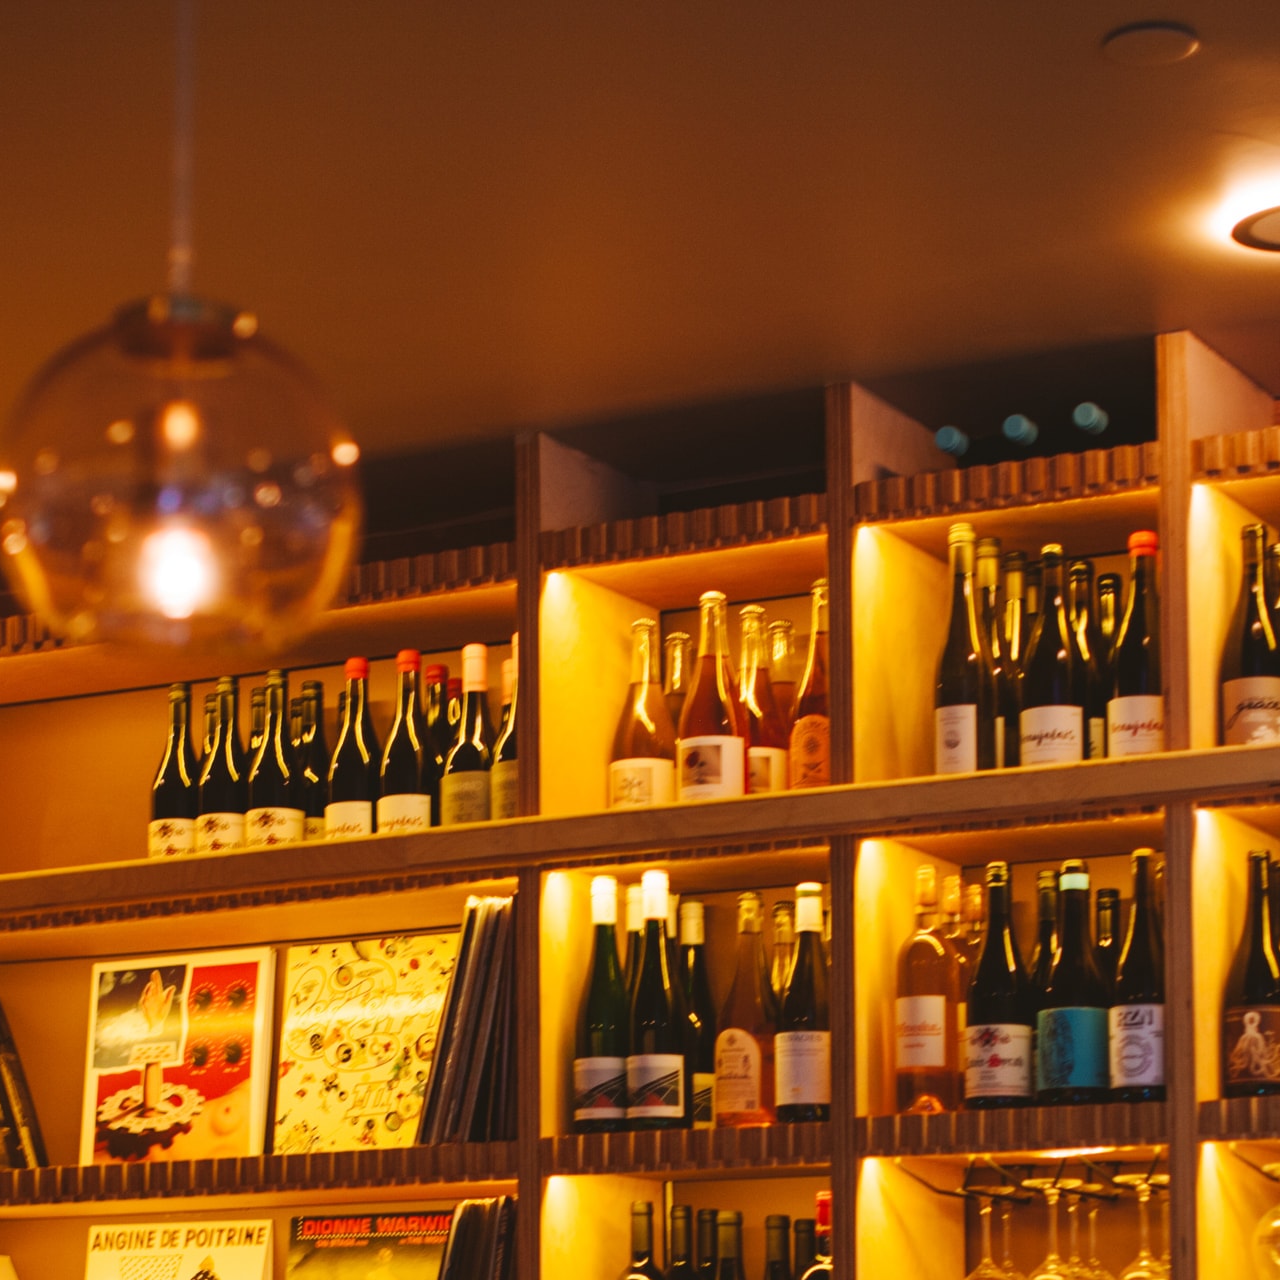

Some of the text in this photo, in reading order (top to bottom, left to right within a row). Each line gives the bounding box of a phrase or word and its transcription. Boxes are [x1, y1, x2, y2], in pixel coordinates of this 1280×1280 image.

[302, 1217, 372, 1236] DIONNE
[91, 1226, 268, 1251] ANGINE DE POITRINE
